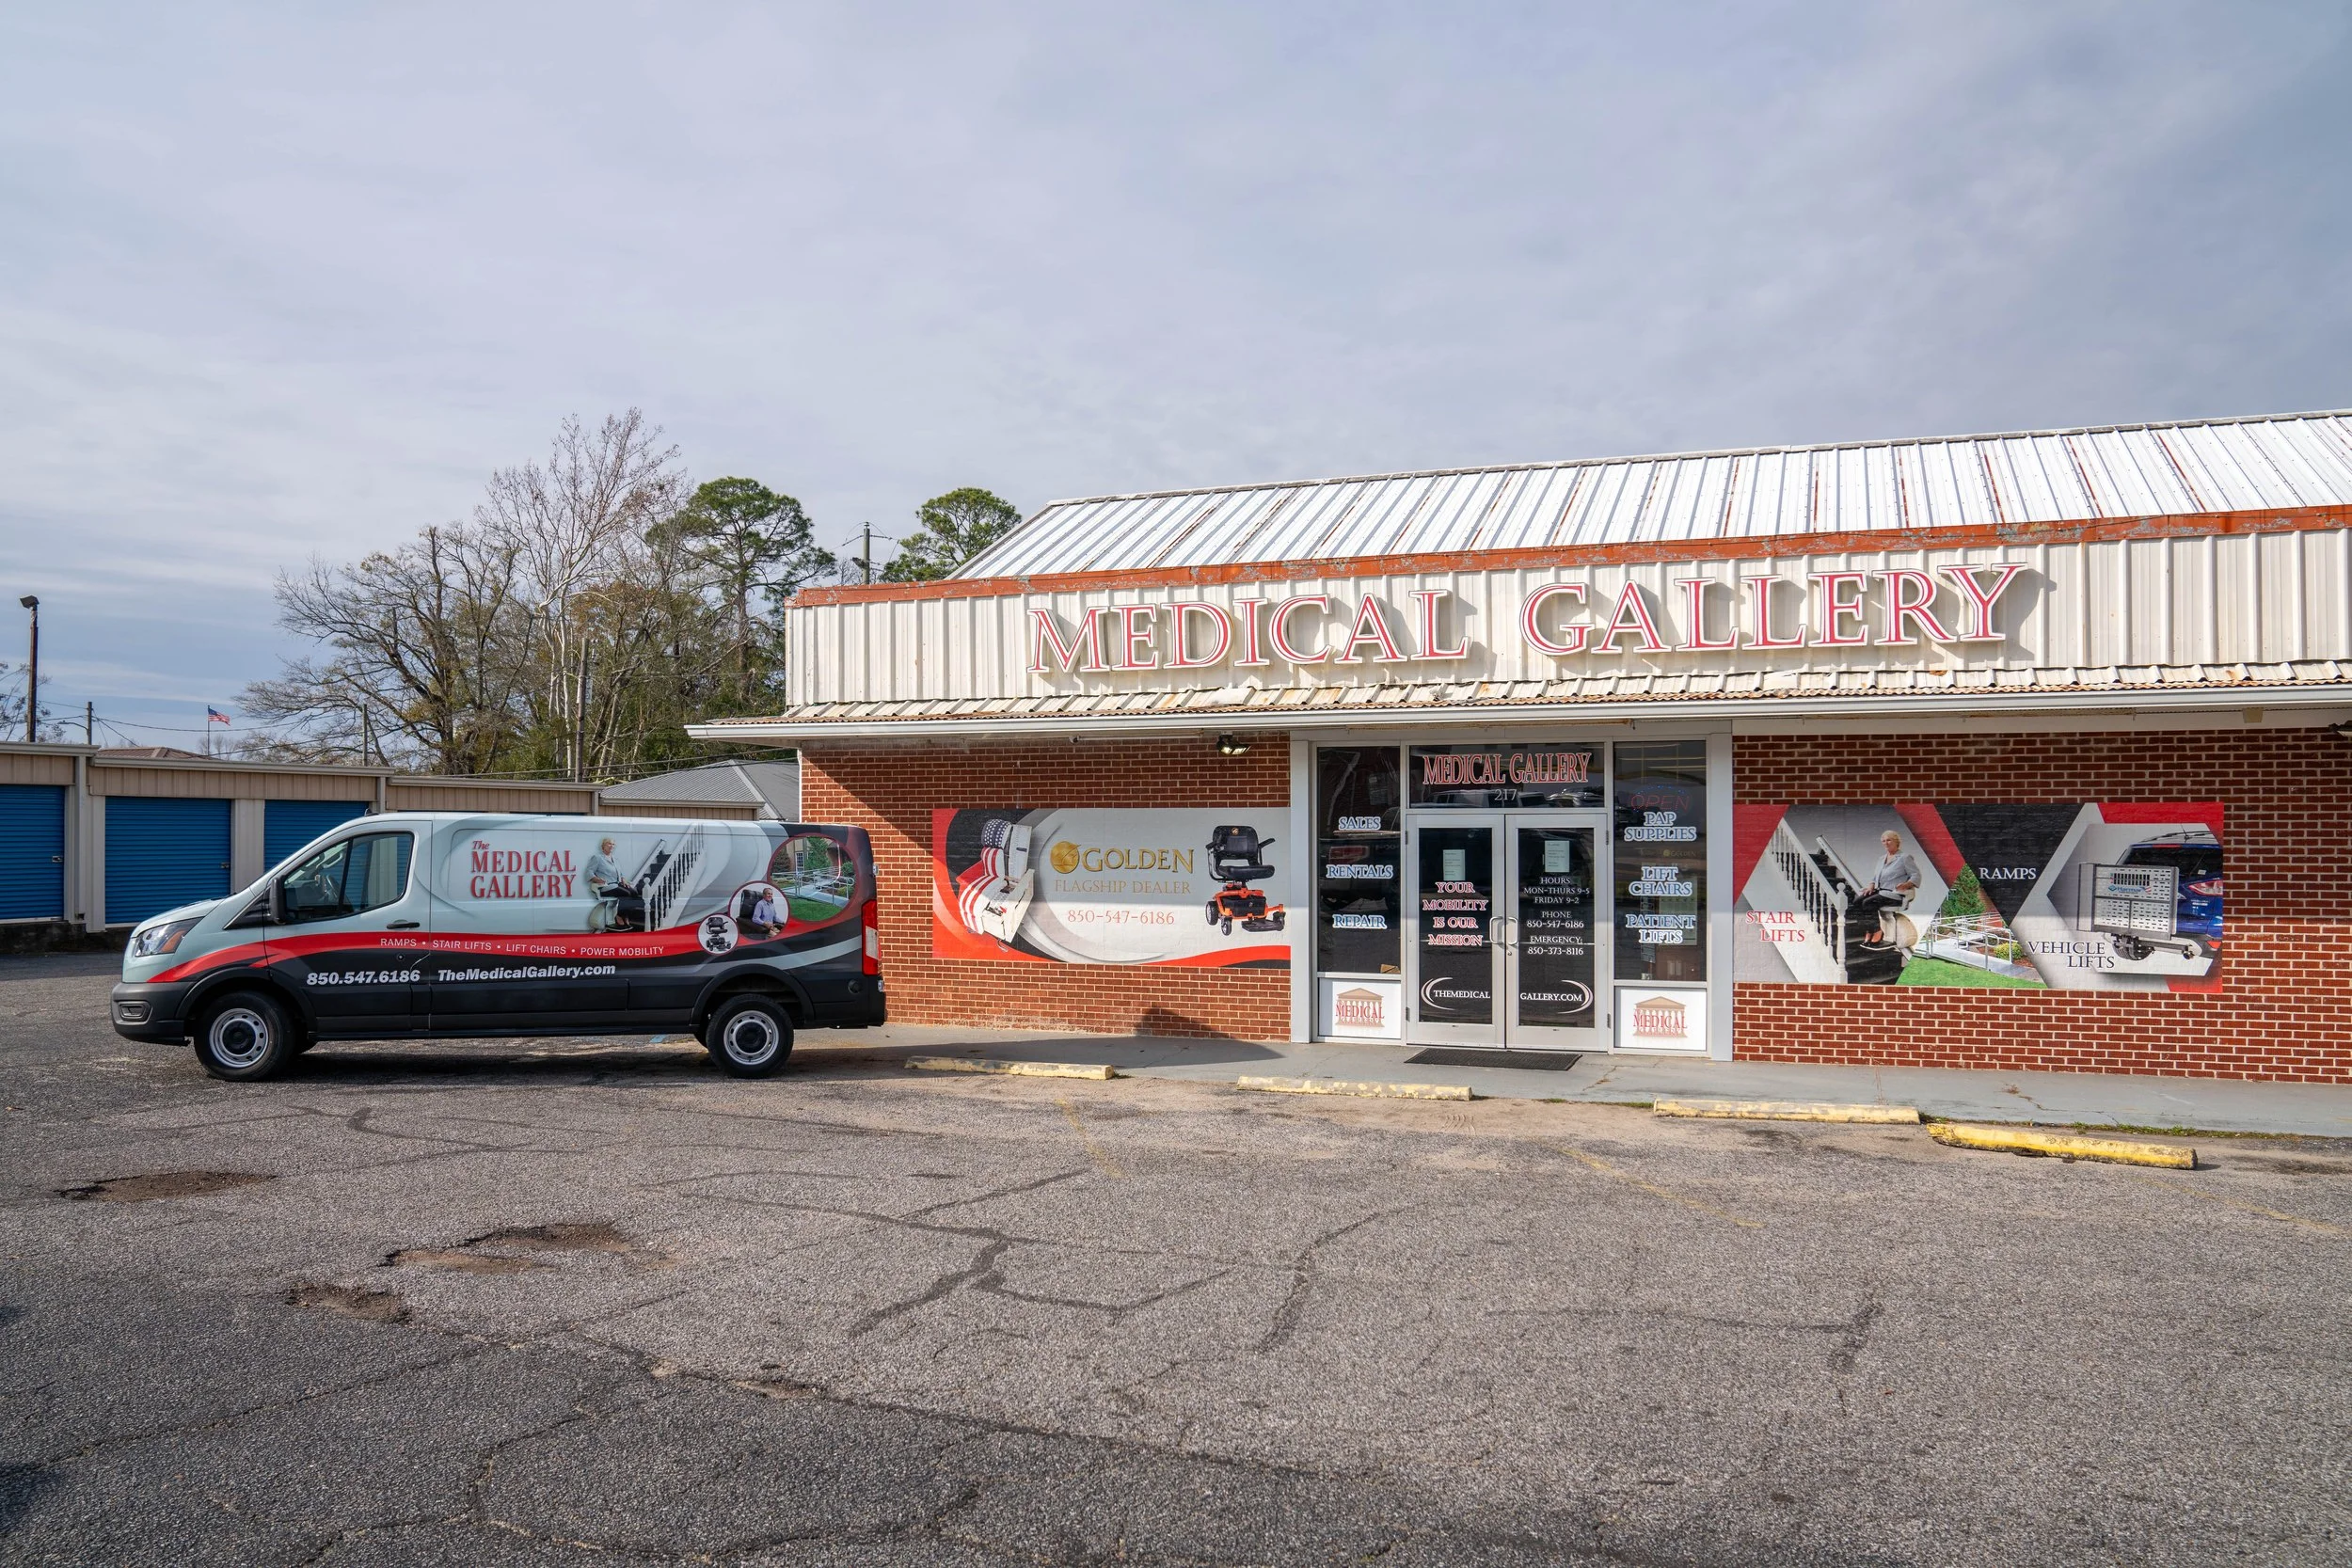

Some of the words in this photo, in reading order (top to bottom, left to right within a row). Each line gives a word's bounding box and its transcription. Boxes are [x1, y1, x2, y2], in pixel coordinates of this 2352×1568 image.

[1026, 589, 1470, 675] MEDICAL
[1519, 562, 2029, 657] GALLERY
[1422, 753, 1506, 785] MEDICAL
[1509, 752, 1593, 784] GALLERY
[1494, 788, 1517, 801] 217
[1630, 795, 1690, 813] OPEN
[1338, 816, 1381, 831] SALES
[1644, 812, 1677, 826] PAP
[1624, 827, 1697, 841] SUPPLIES
[472, 840, 490, 849] The
[471, 850, 576, 873] MEDICAL
[1082, 848, 1193, 875] GOLDEN
[1326, 864, 1393, 879] RENTALS
[1642, 866, 1678, 880] LIFT
[1979, 867, 2037, 880] RAMPS
[471, 874, 576, 898] GALLERY
[1054, 879, 1127, 893] FLAGSHIP
[1132, 879, 1191, 894] DEALER
[1436, 881, 1476, 894] YOUR
[1523, 886, 1575, 895] MON-THURS
[1577, 886, 1590, 895] 9-5
[1629, 881, 1692, 896] CHAIRS
[1422, 899, 1488, 911] MOBILITY
[1534, 896, 1564, 905] FRIDAY
[1565, 896, 1580, 905] 9-2
[1067, 911, 1175, 925] 850-547-6186
[1332, 914, 1388, 929] REPAIR
[1541, 911, 1571, 919] PHONE
[1626, 914, 1696, 929] PATIENT
[1746, 911, 1796, 925] STAIR
[1433, 916, 1446, 929] IS
[1448, 916, 1479, 929] OUR
[1526, 921, 1584, 929] 850-547-6186
[1428, 934, 1484, 947] MISSION
[1530, 935, 1583, 944] EMERGENCY:
[1639, 929, 1683, 944] LIFTS
[1760, 928, 1805, 942] LIFTS
[465, 942, 491, 950] LIFTS
[506, 943, 526, 953] LIFT
[530, 945, 566, 955] CHAIRS
[580, 947, 615, 956] POWER
[619, 946, 664, 956] MOBILITY
[1527, 946, 1583, 956] 850-373-8116
[2028, 941, 2106, 955] VEHICLE
[2068, 955, 2115, 969] LIFTS
[307, 970, 421, 985] 850.547.6186
[437, 965, 616, 982] TheMedicalGallery.com
[1433, 990, 1491, 1000] THEMEDICAL
[1519, 992, 1582, 1003] GALLERY.COM
[1335, 1005, 1385, 1019] MEDICAL
[1633, 1014, 1688, 1029] MEDICAL
